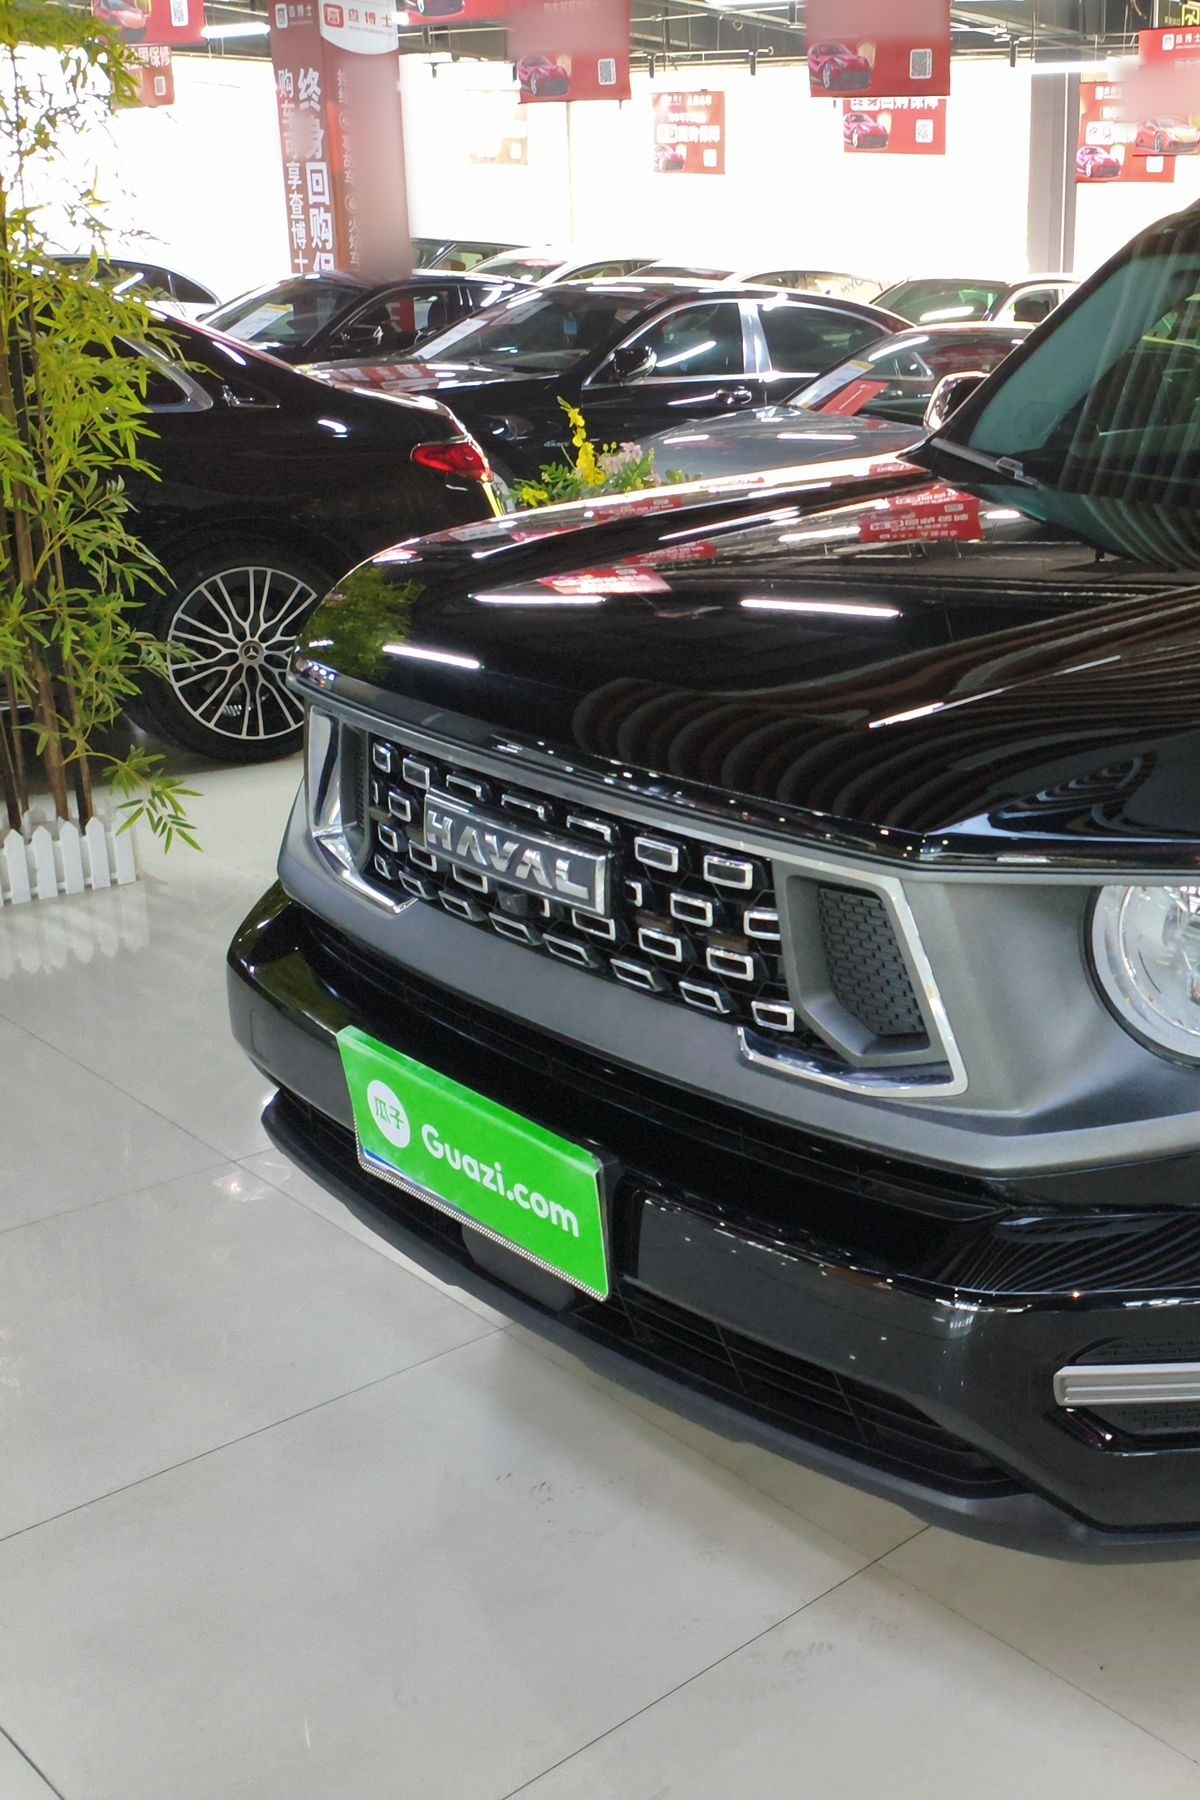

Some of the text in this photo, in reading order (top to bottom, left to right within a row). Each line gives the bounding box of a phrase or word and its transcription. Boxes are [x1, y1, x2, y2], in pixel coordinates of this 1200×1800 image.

[427, 810, 592, 900] HAVAL
[374, 1096, 404, 1130] 瓜子
[421, 1123, 579, 1238] Guazi.com
